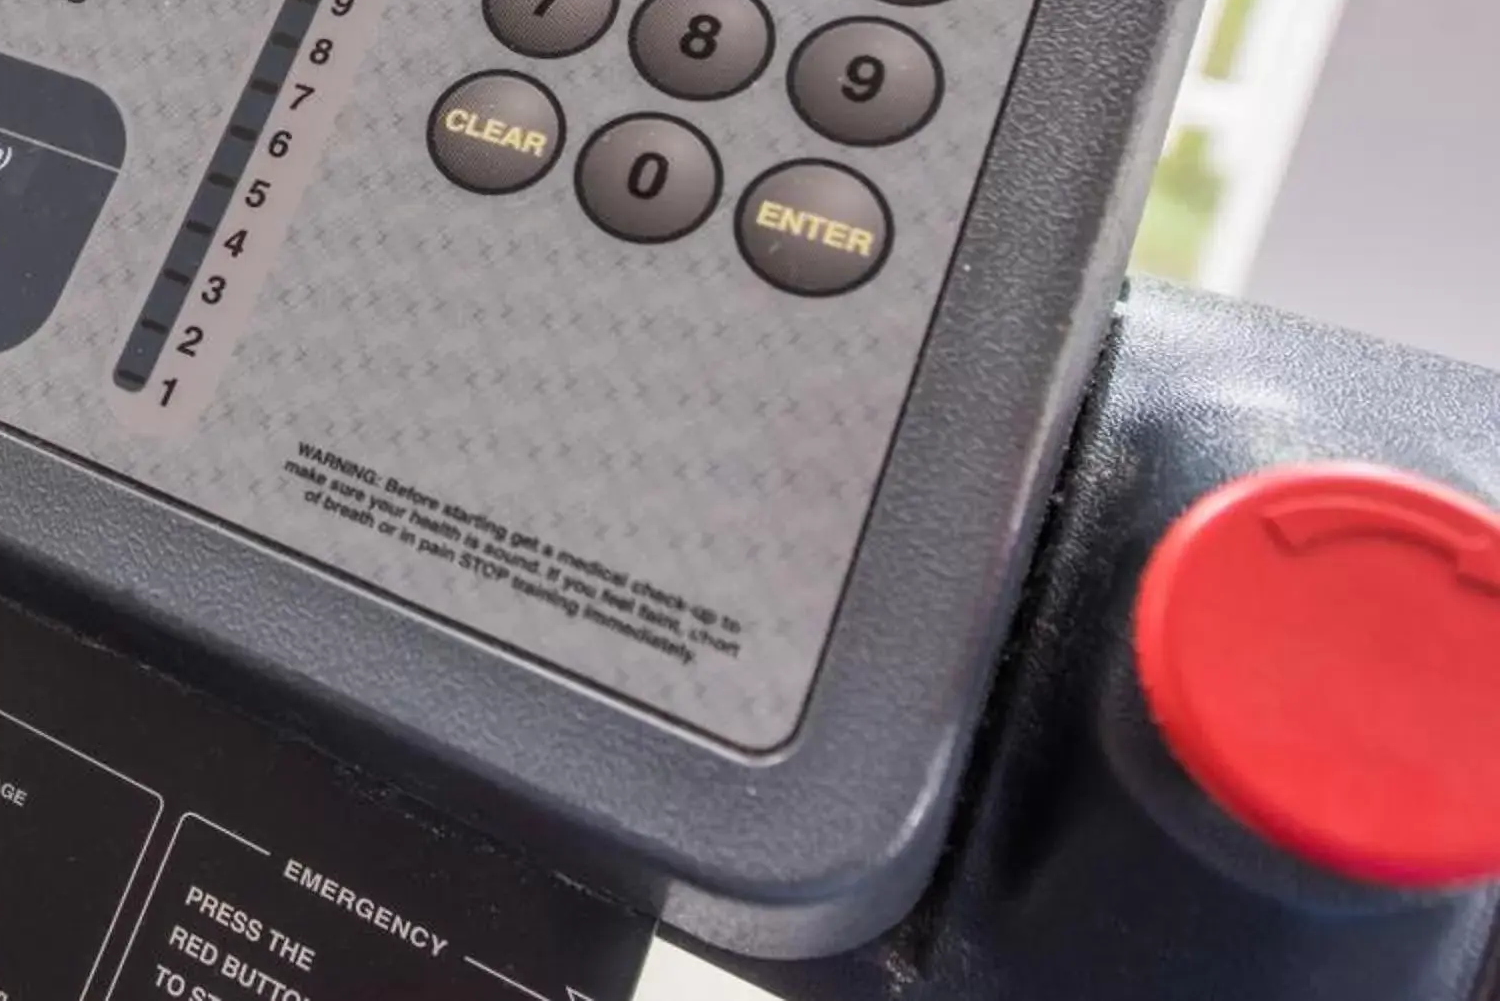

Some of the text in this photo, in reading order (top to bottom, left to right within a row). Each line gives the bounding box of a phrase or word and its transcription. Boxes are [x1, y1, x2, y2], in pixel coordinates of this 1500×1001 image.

[309, 38, 334, 65] 8
[679, 14, 721, 59] 8
[289, 85, 316, 110] 7
[841, 55, 885, 102] 9
[268, 130, 292, 158] 6
[444, 109, 548, 156] CLEAR
[244, 179, 272, 207] 5
[626, 152, 668, 198] 0
[224, 229, 249, 258] 4
[755, 200, 873, 256] ENTER
[201, 275, 227, 305] 3
[177, 326, 205, 357] 2
[159, 378, 179, 407] 1
[284, 460, 327, 486] make
[330, 479, 366, 501] sure
[369, 495, 406, 518] your
[409, 510, 462, 541] health
[463, 533, 479, 549] is
[563, 576, 597, 599] you
[298, 442, 382, 487] WARNING:
[384, 478, 440, 510] Before
[442, 504, 508, 541] starting
[510, 532, 539, 552] get
[557, 551, 629, 587] medical
[304, 490, 322, 504] of
[323, 496, 375, 528] breath
[377, 520, 398, 536] or
[399, 528, 416, 545] in
[416, 538, 455, 563] pain
[458, 552, 510, 581] STOP
[511, 576, 580, 617] training
[184, 885, 316, 972] PRESS THE
[282, 858, 449, 959] EMERGENCY
[155, 964, 186, 997] TO
[168, 924, 312, 1001] RED BUTTO
